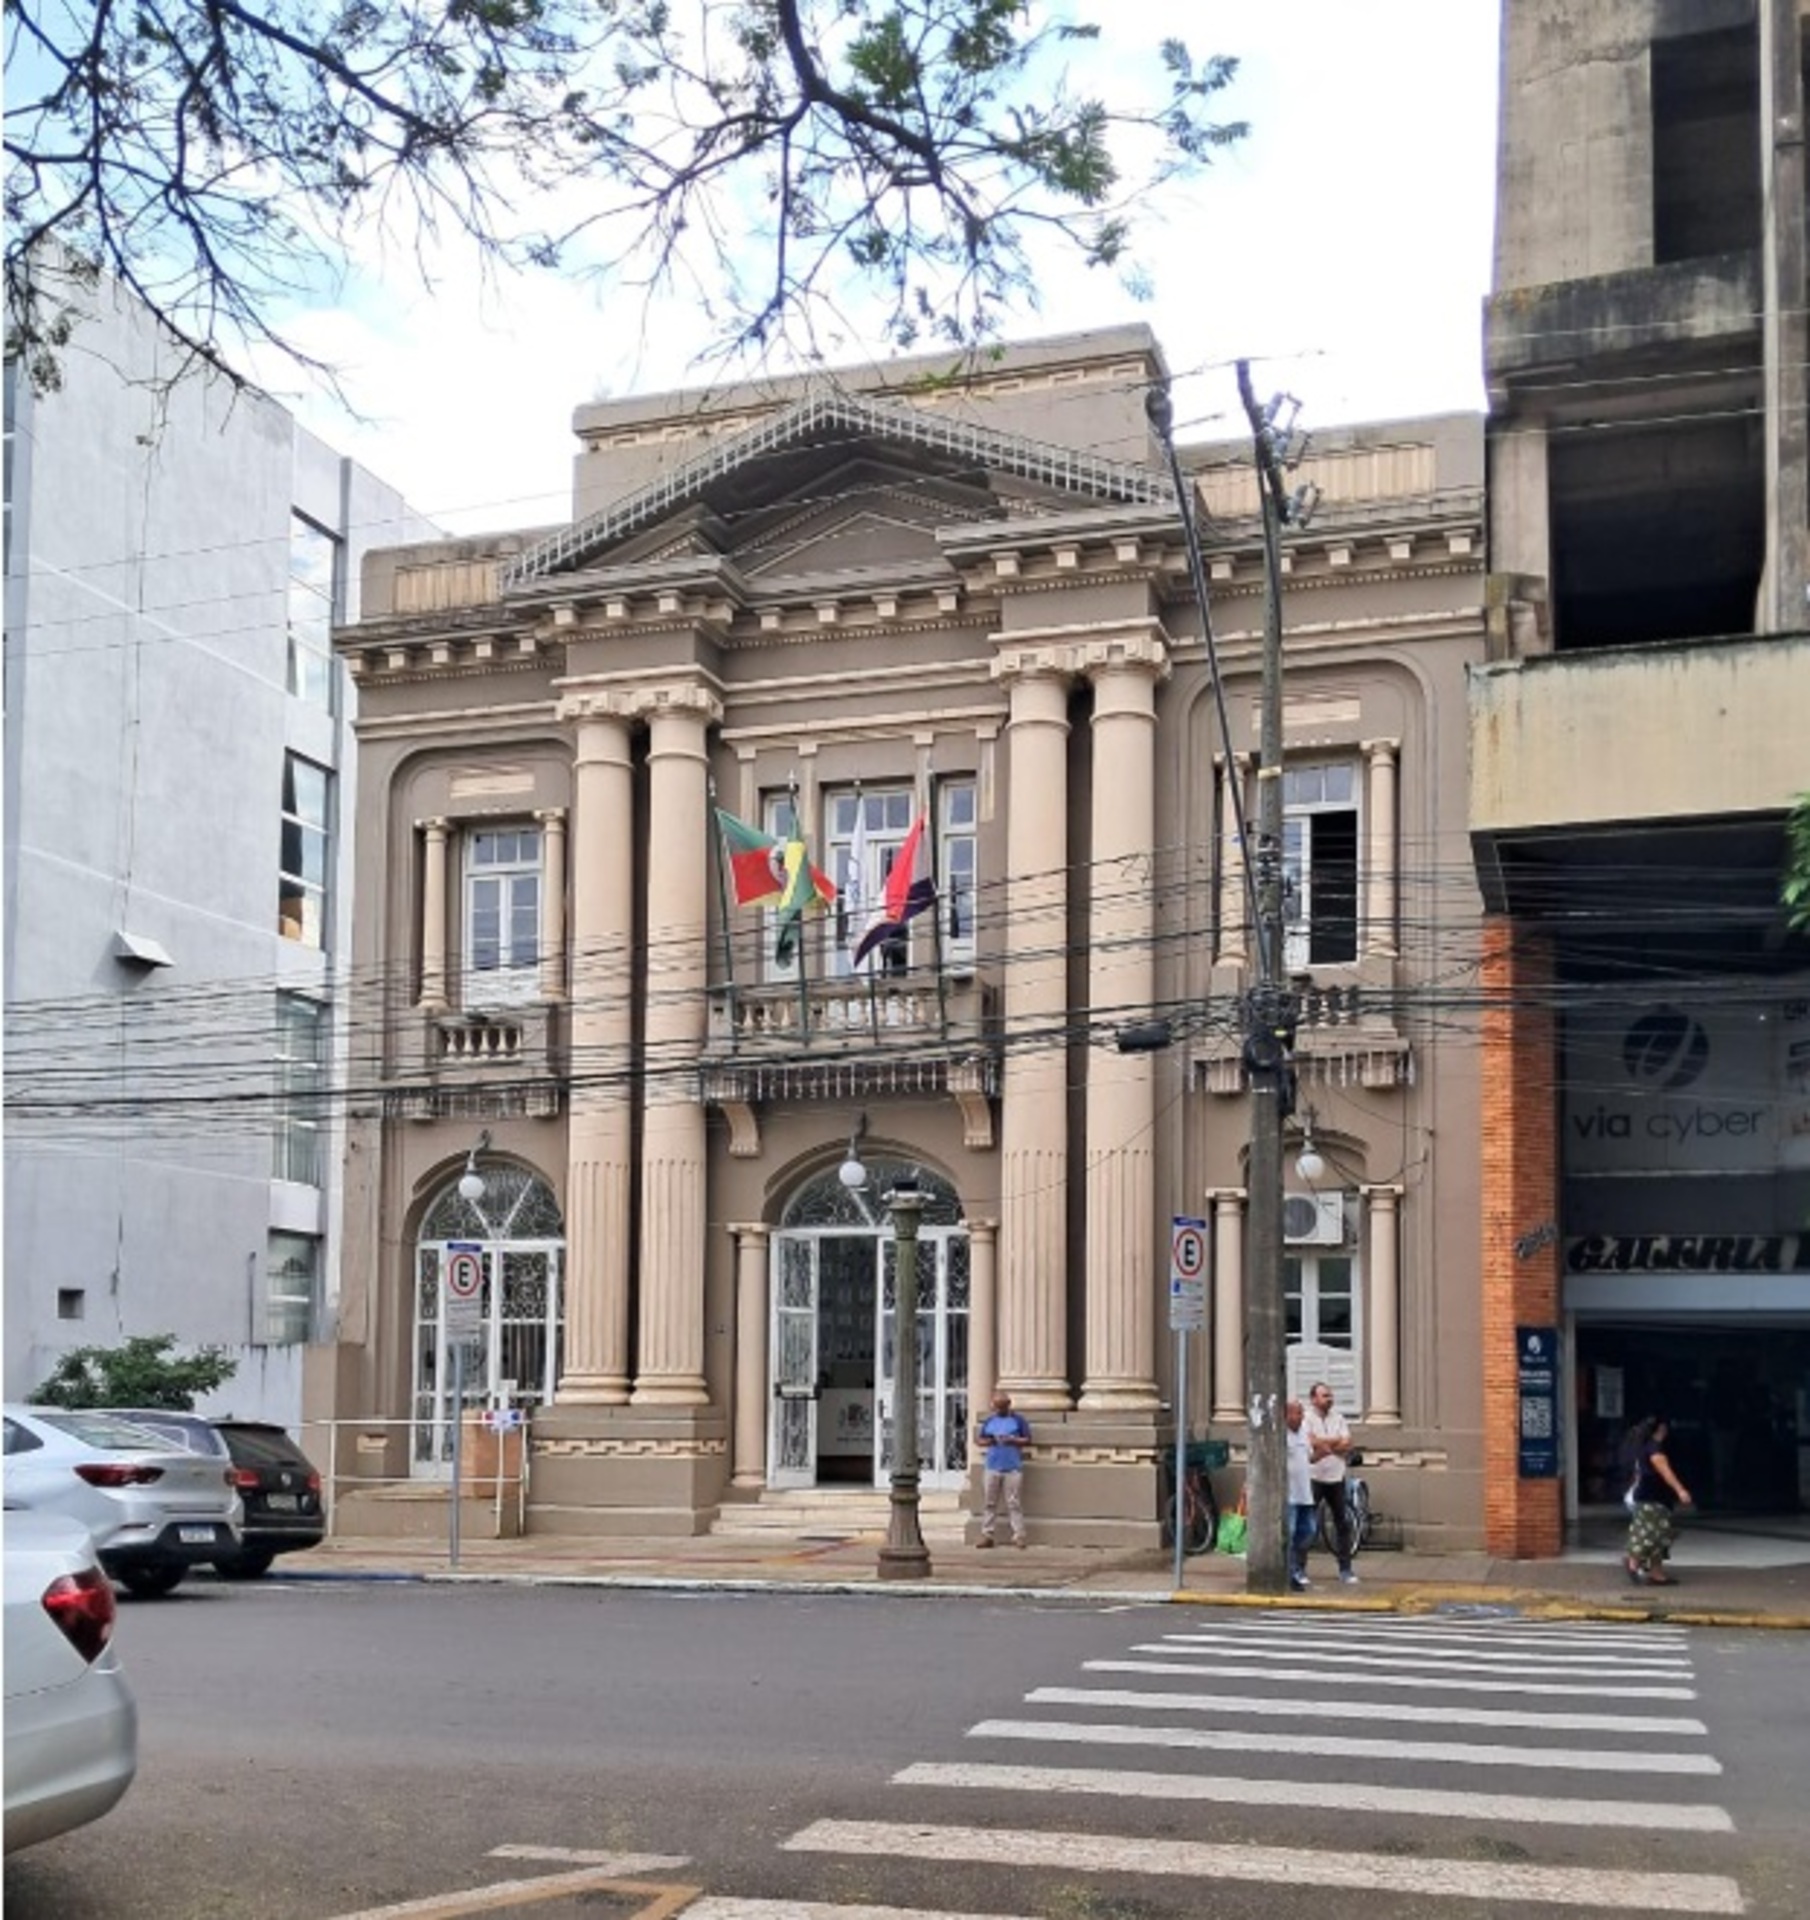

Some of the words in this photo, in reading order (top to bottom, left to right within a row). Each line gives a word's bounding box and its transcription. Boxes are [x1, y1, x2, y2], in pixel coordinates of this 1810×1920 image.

[1572, 1106, 1632, 1139] via
[1645, 1106, 1765, 1145] cyber
[1184, 1238, 1195, 1267] E
[1568, 1236, 1784, 1271] GALERIA
[458, 1261, 470, 1288] E
